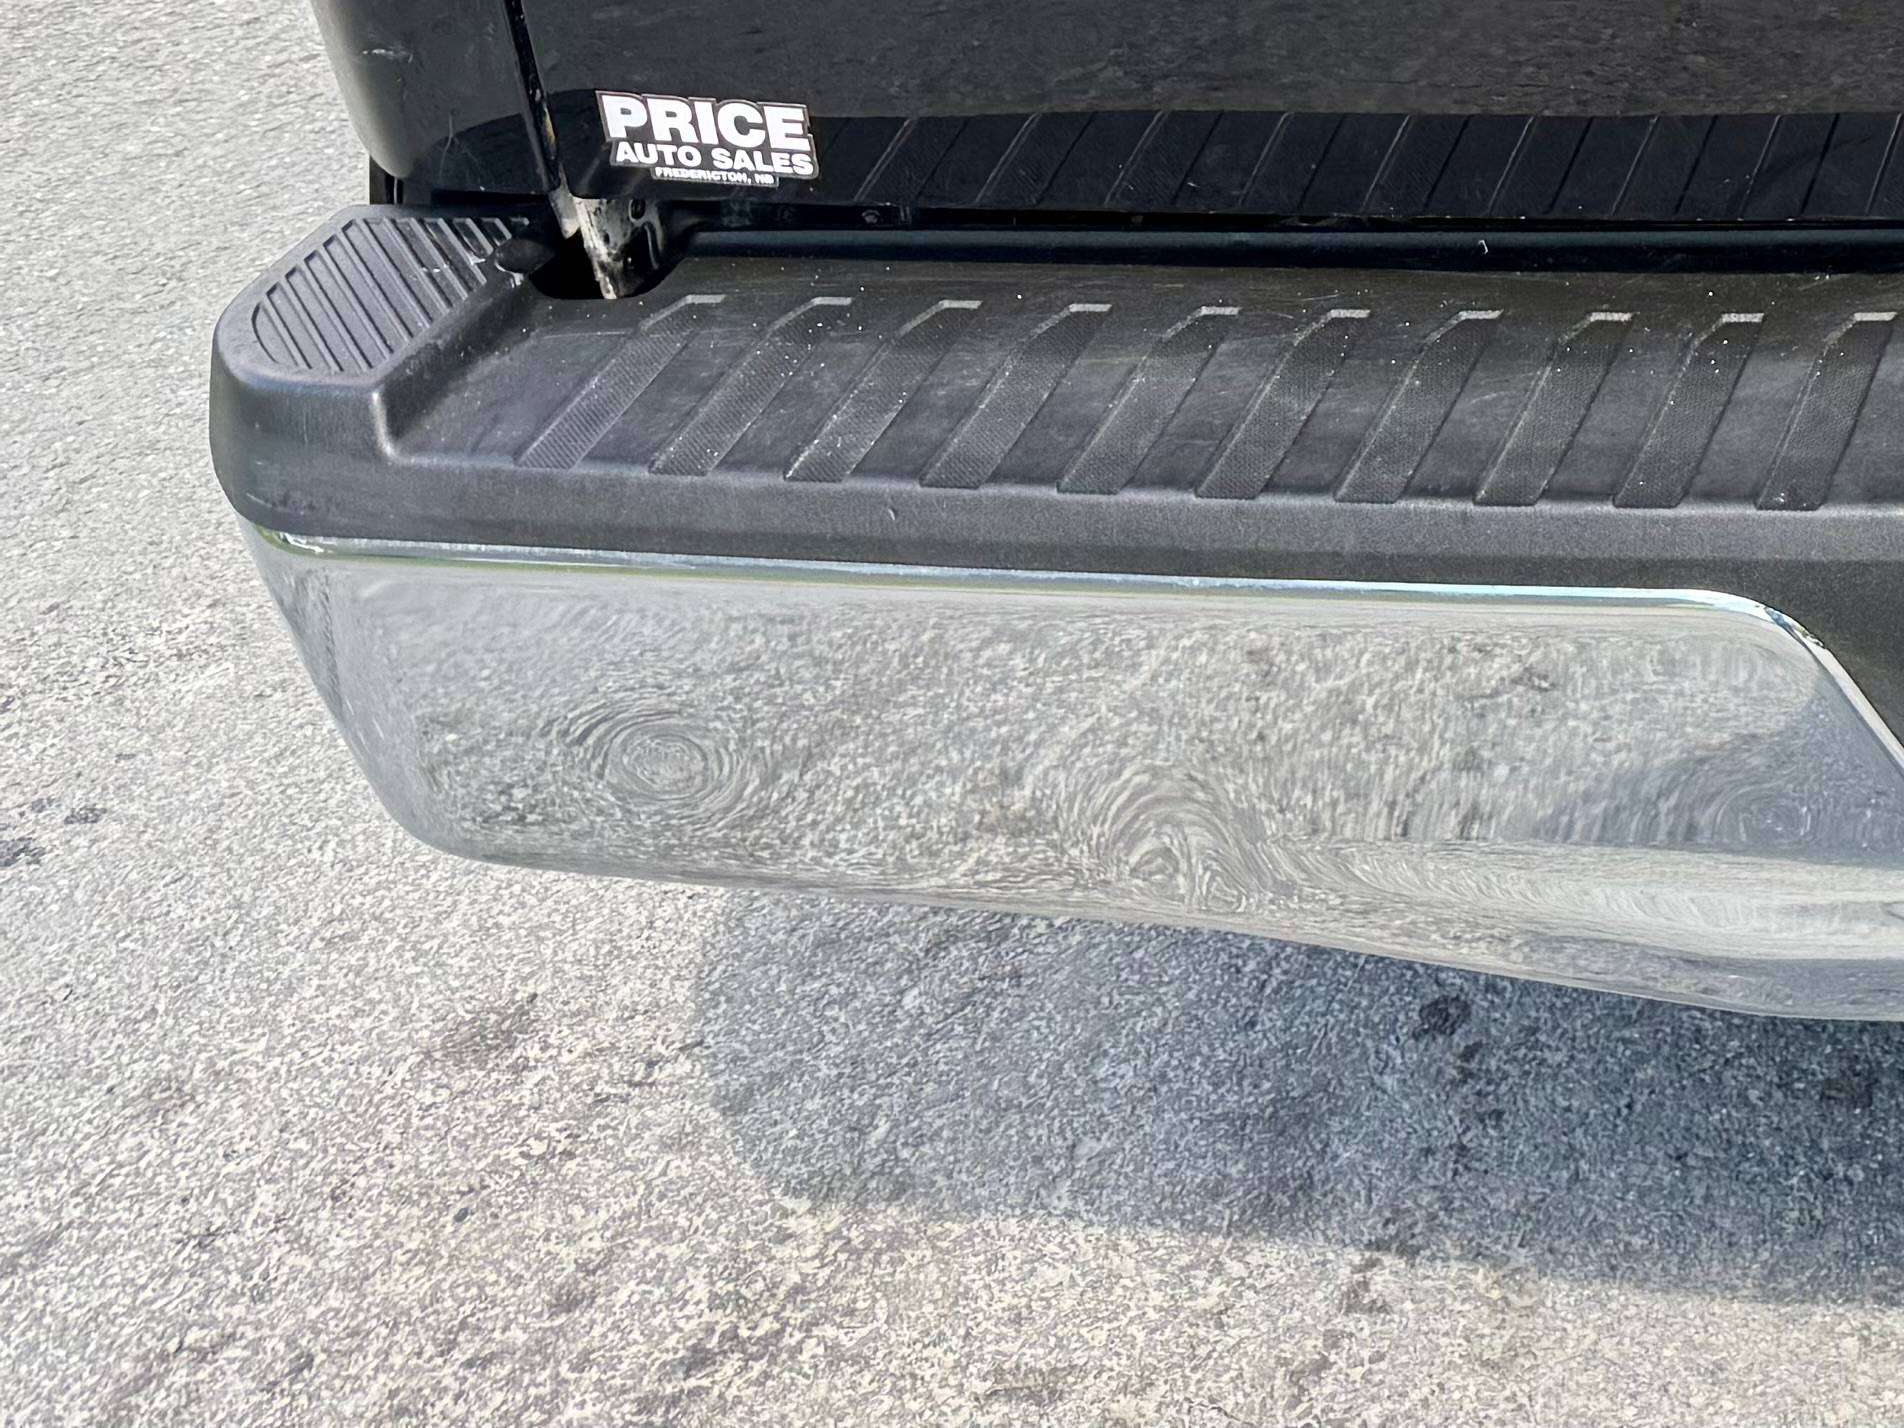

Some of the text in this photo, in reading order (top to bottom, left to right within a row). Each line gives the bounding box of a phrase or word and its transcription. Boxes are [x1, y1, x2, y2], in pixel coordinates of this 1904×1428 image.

[600, 93, 812, 152] PRICE
[616, 141, 814, 175] AUTO SALES
